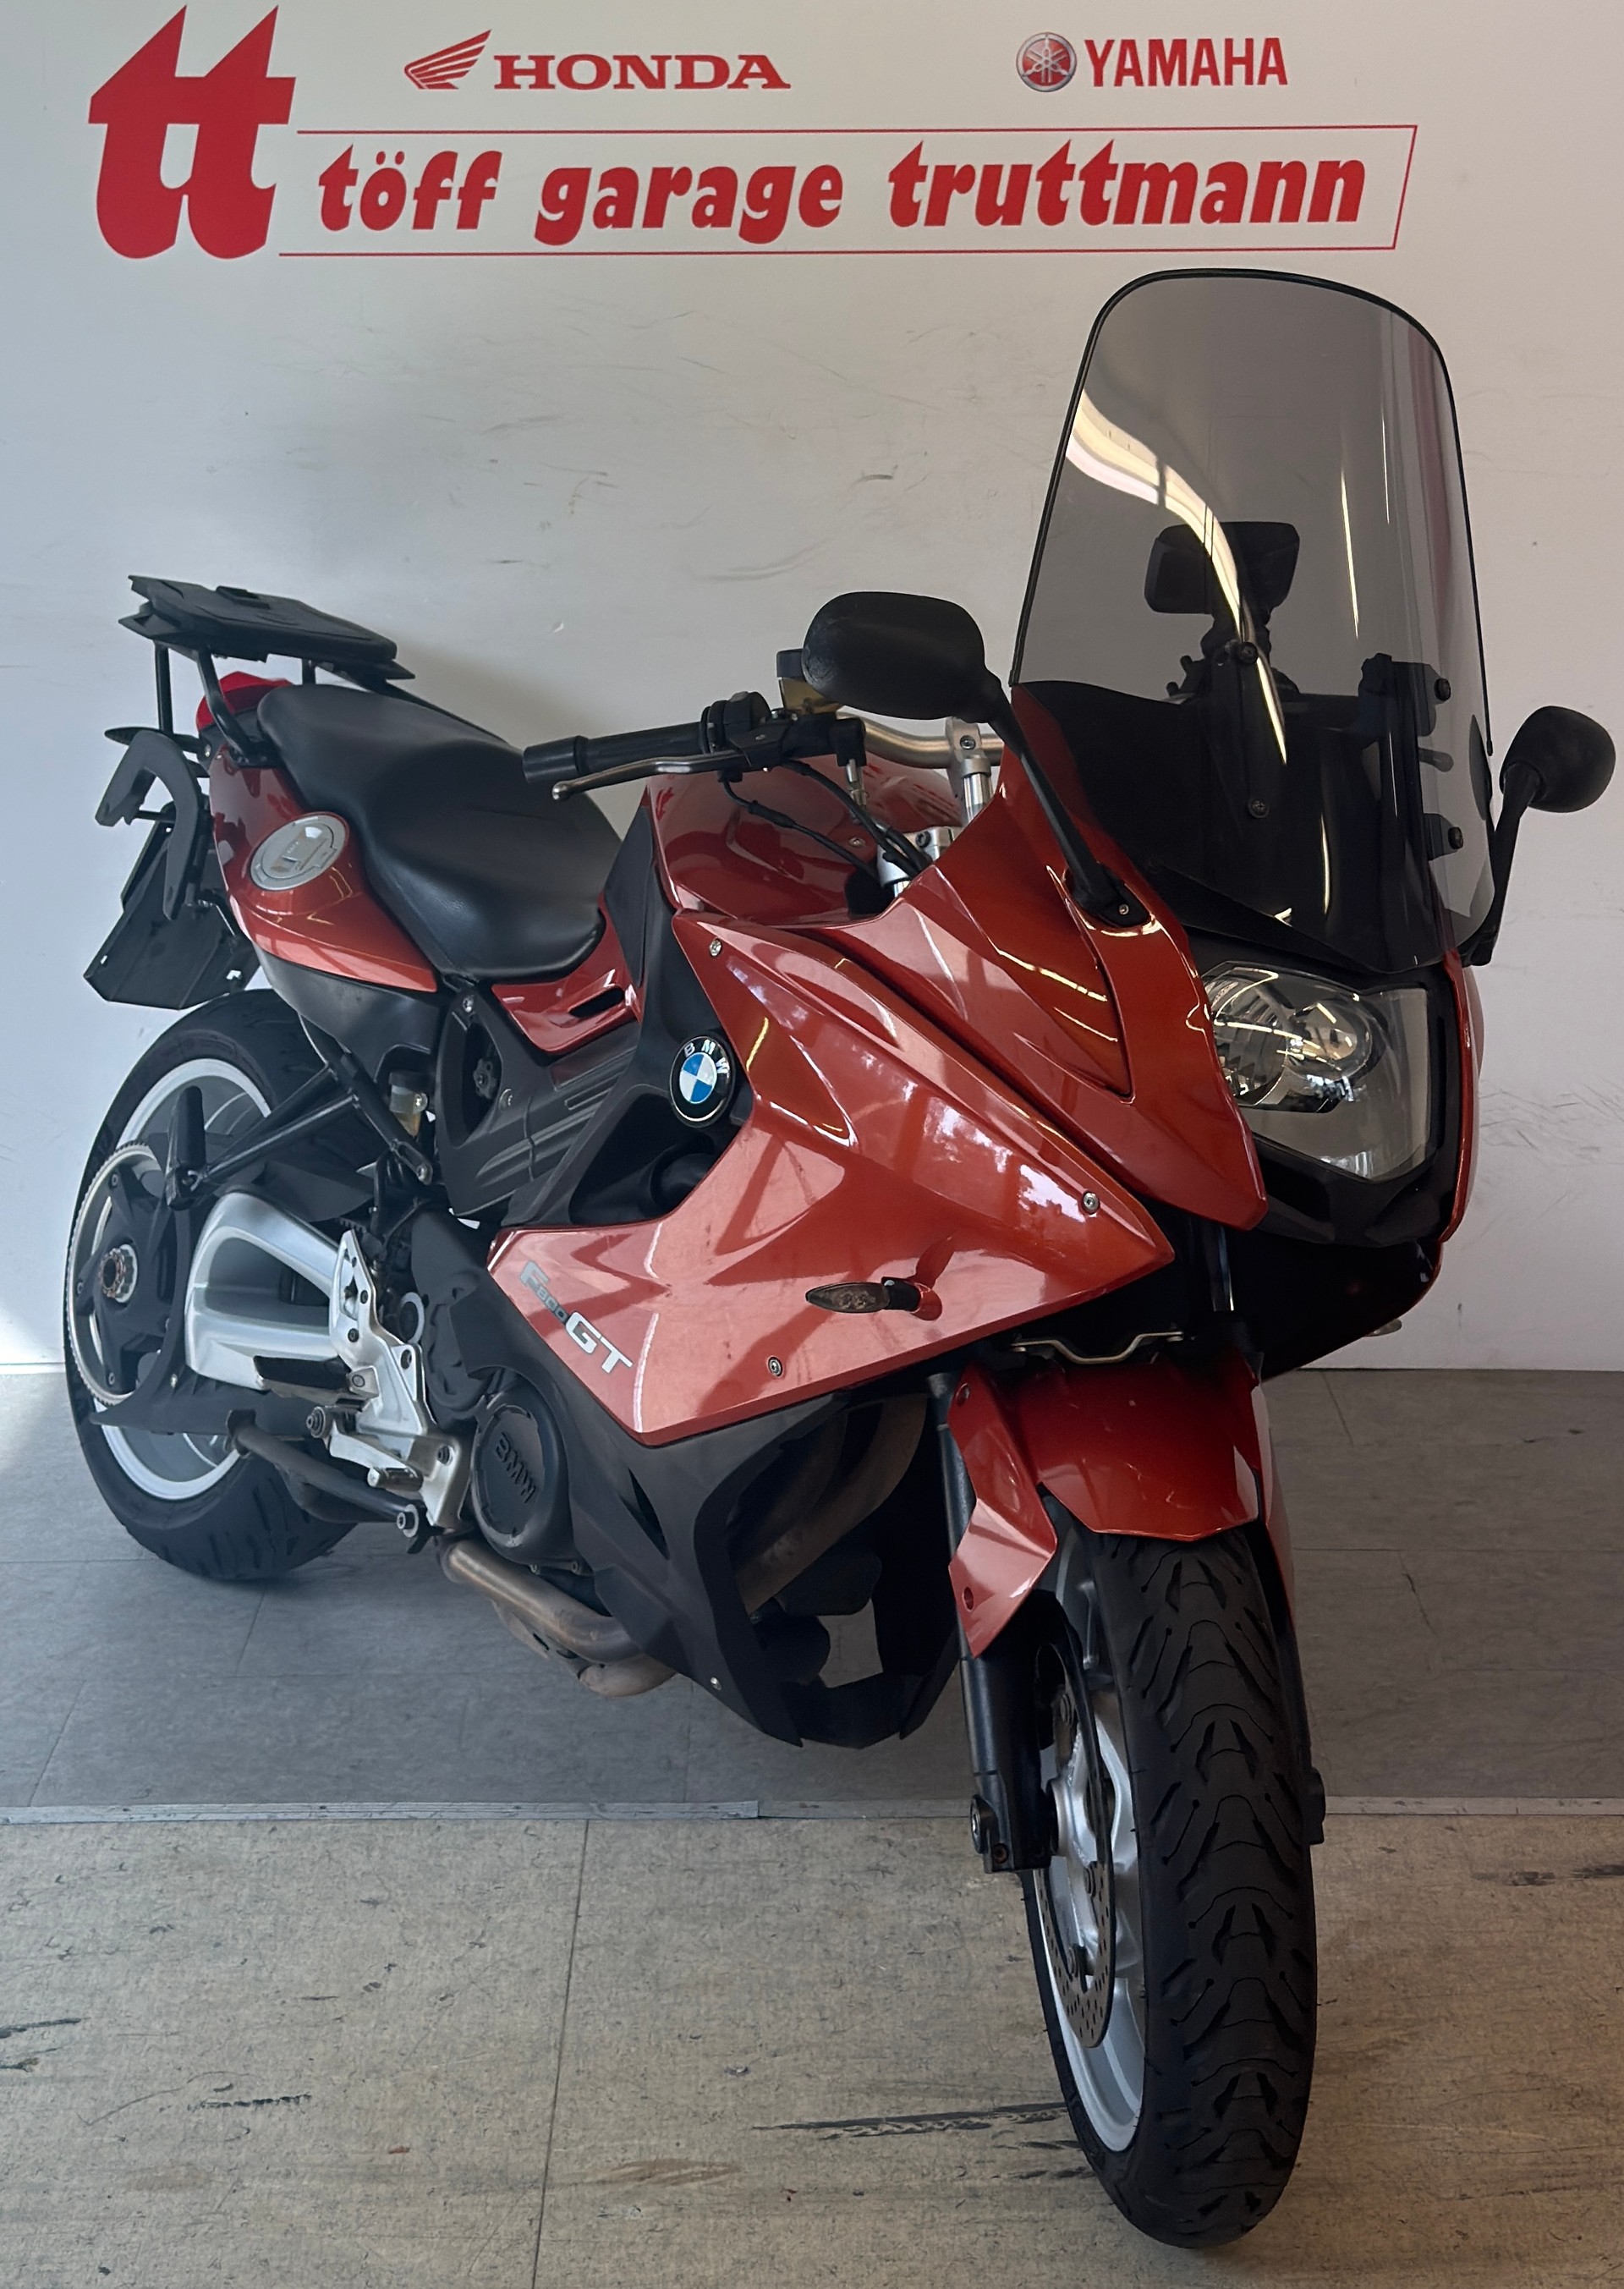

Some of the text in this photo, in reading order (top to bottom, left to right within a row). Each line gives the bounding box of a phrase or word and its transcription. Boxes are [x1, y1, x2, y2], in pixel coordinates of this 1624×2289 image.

[493, 54, 792, 91] HONDA
[1084, 37, 1288, 88] YAMAHA
[88, 7, 296, 260] tt
[318, 140, 1366, 245] töff garage truttmann
[683, 1039, 730, 1074] BMW
[495, 1431, 537, 1504] BMW
